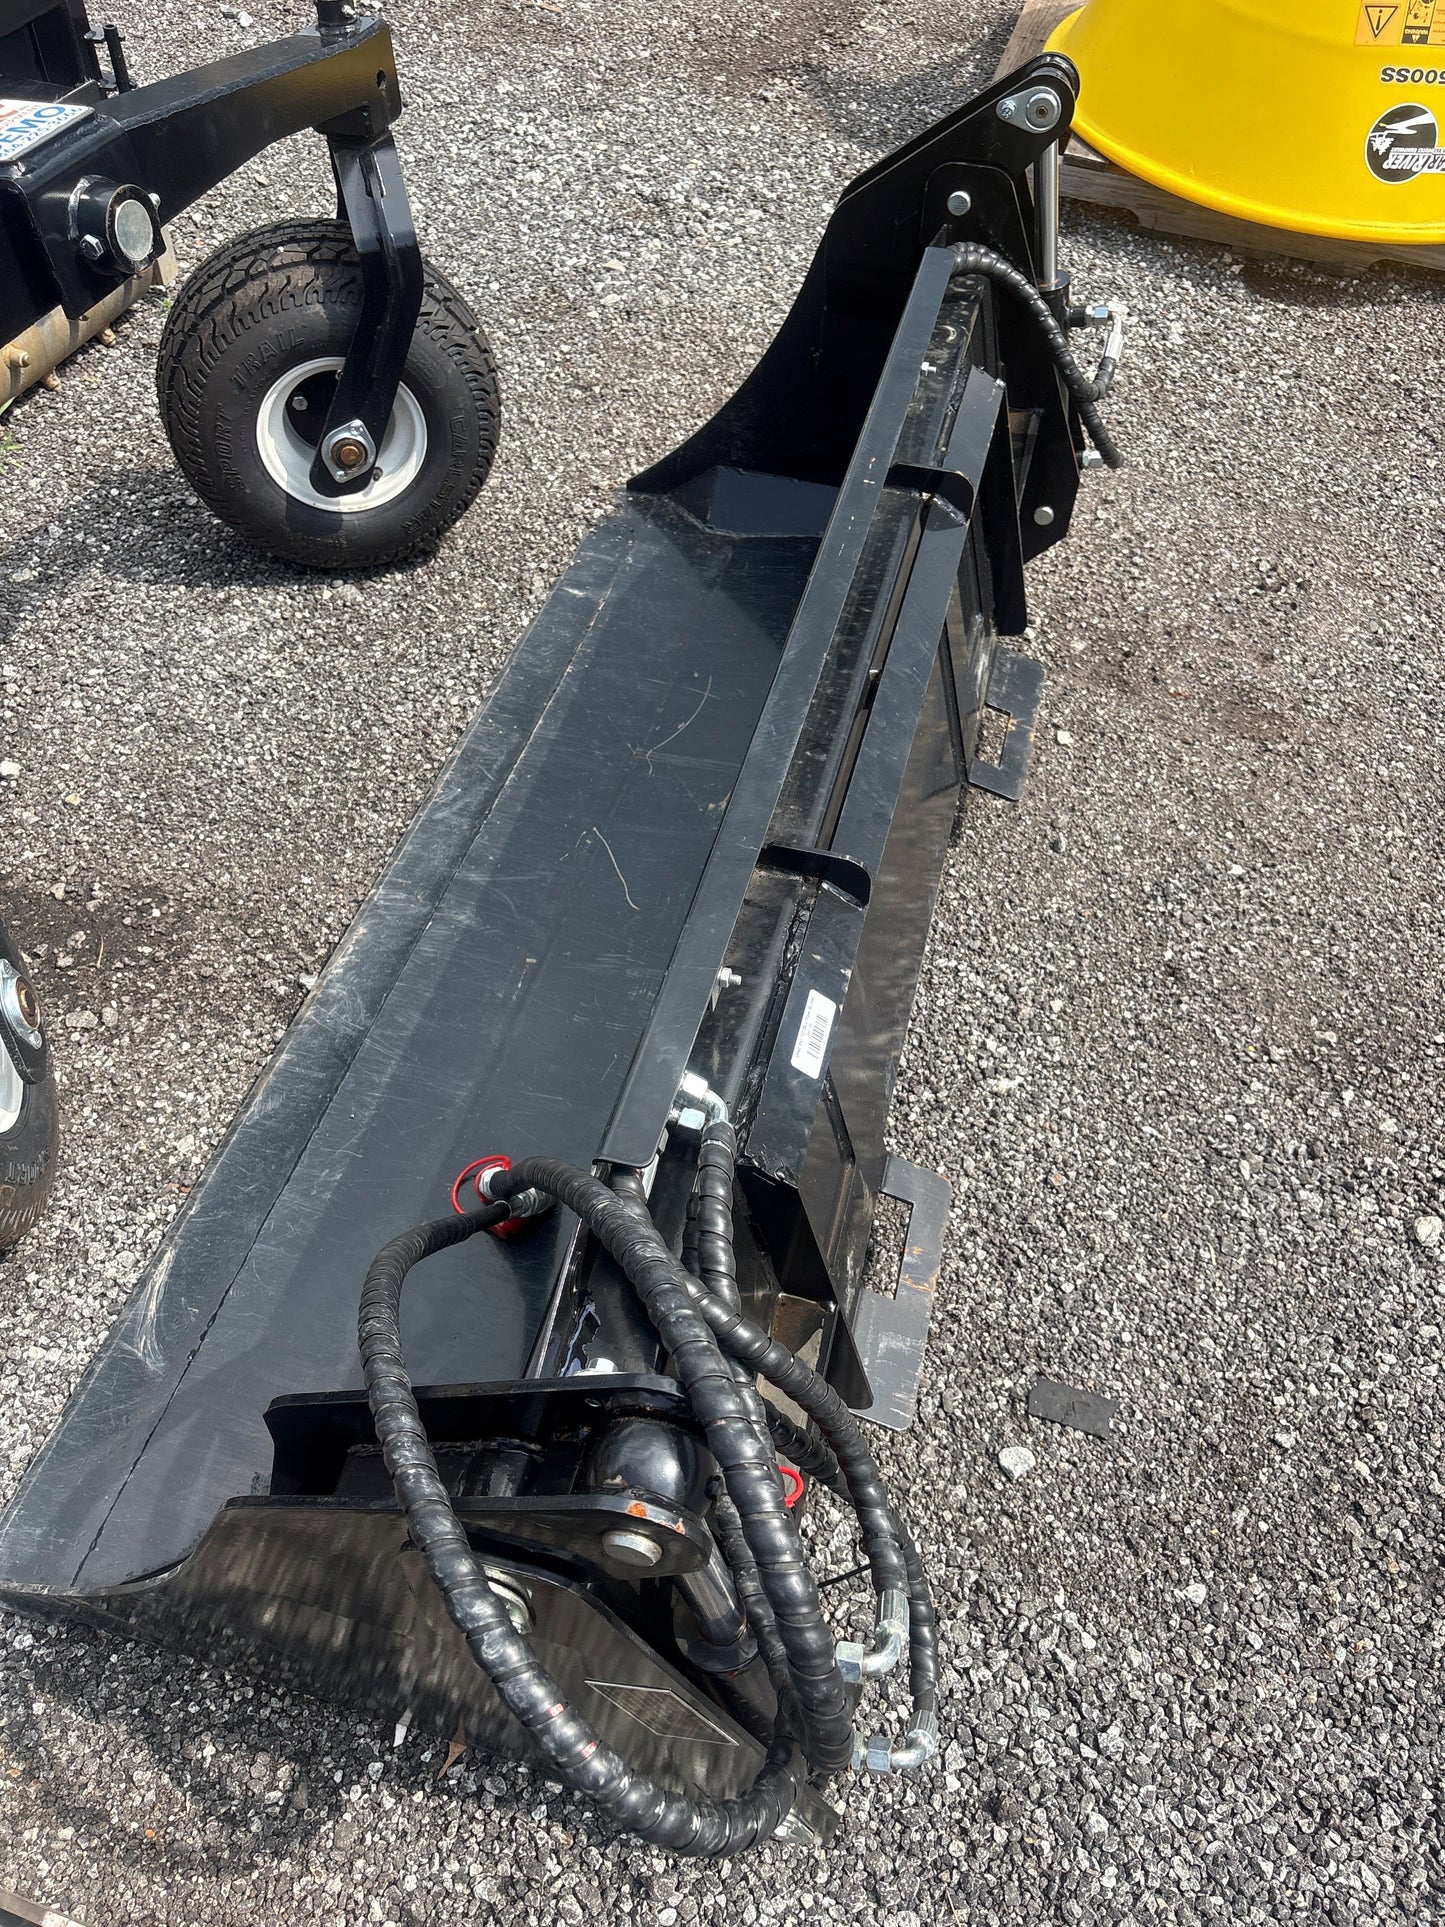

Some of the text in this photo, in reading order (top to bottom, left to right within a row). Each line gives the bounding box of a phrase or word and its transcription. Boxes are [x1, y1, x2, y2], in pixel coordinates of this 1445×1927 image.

[0, 106, 66, 150] EMO
[214, 402, 245, 490] SPORT
[230, 328, 305, 389] TRAIL
